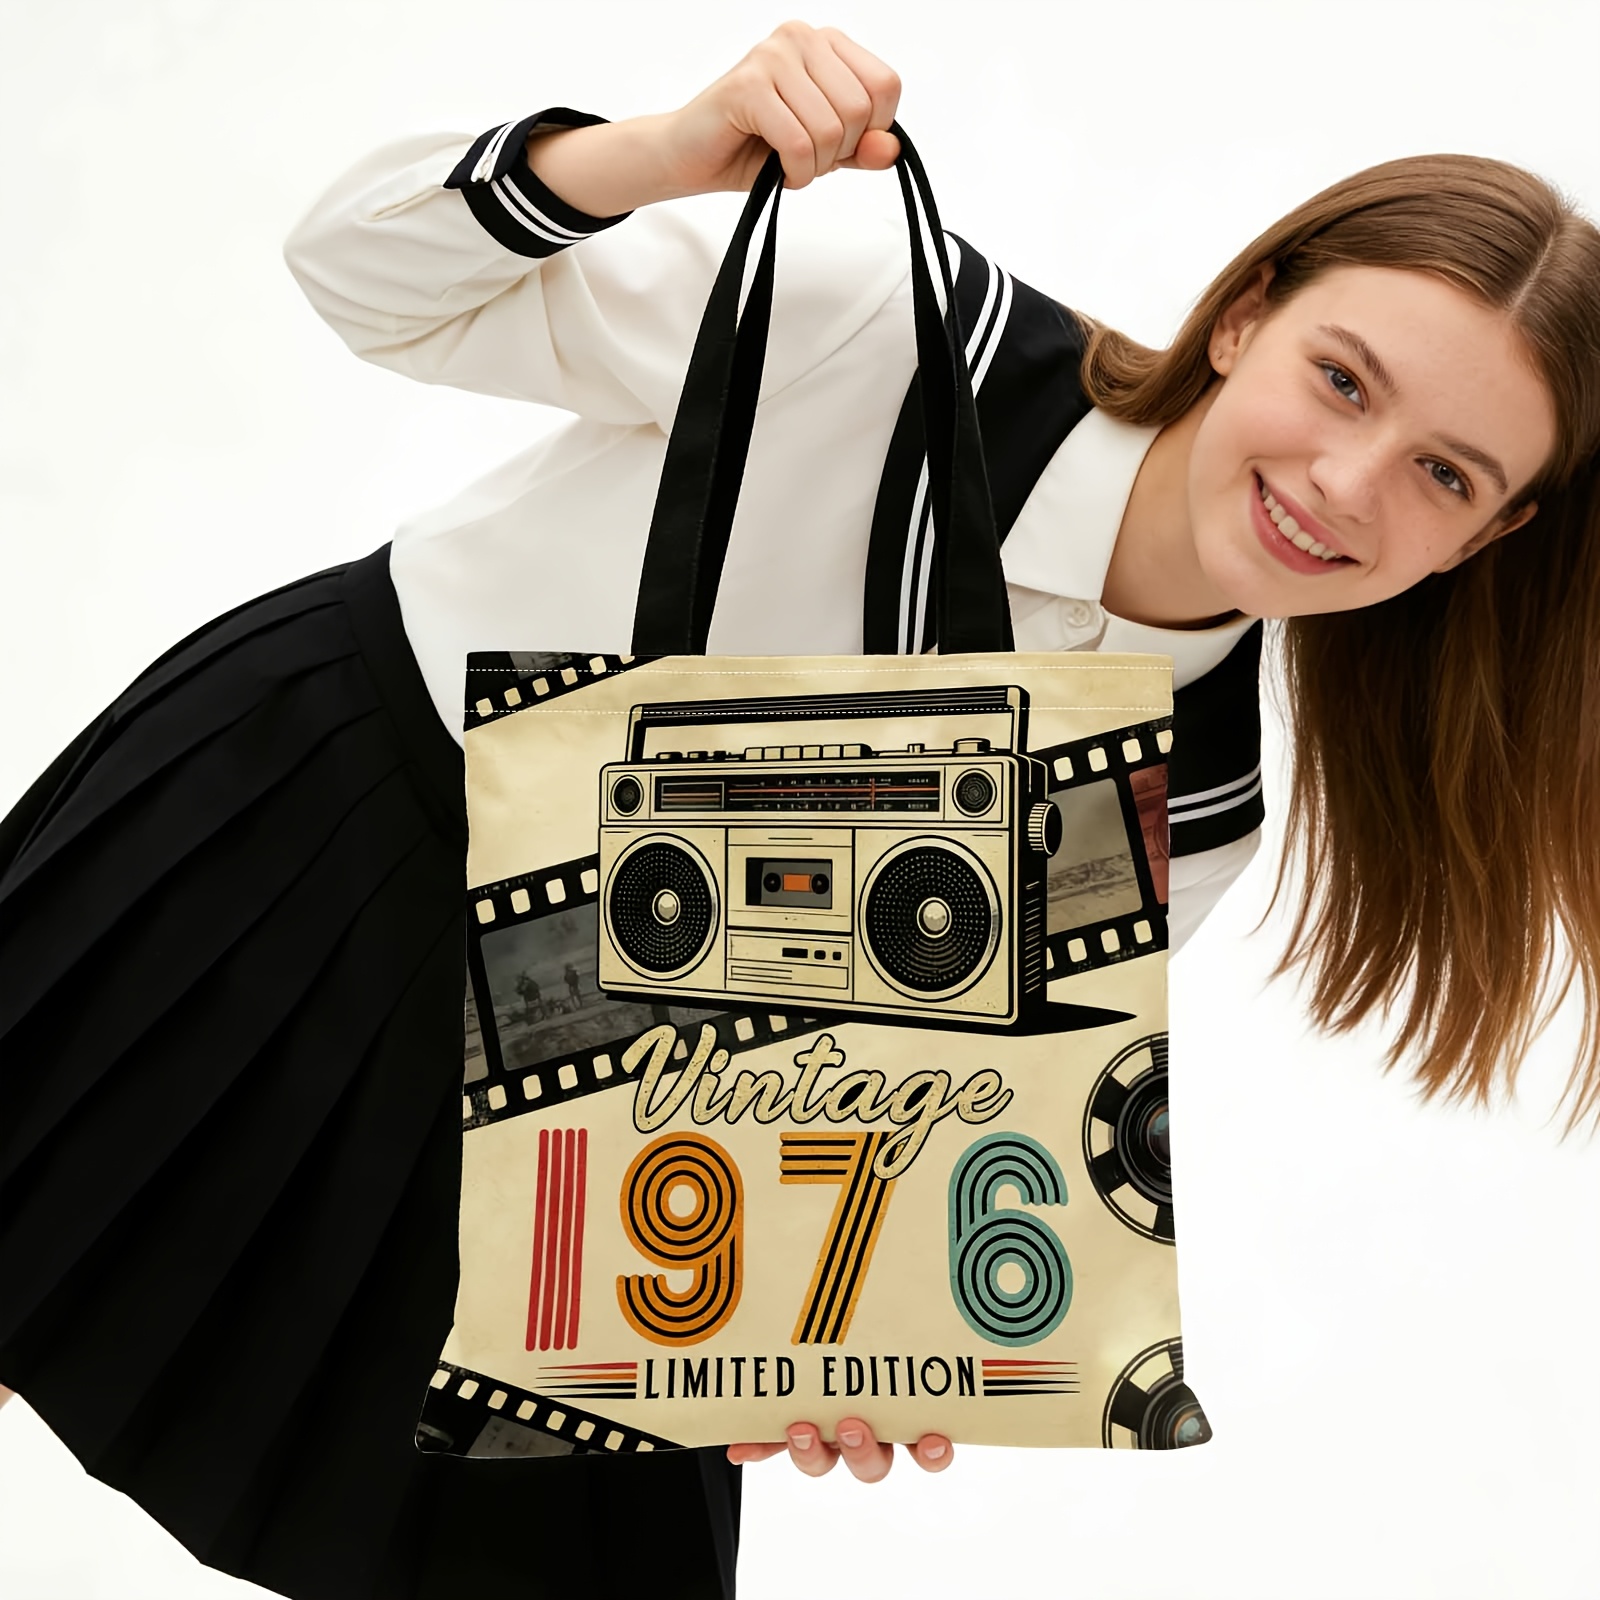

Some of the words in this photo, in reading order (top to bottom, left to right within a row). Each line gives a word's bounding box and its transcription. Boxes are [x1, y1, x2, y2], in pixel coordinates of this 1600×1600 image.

[621, 1024, 1013, 1179] Vintage
[525, 1128, 1074, 1350] 1976
[644, 1356, 795, 1400] LIMITED
[822, 1355, 978, 1398] EDITION
